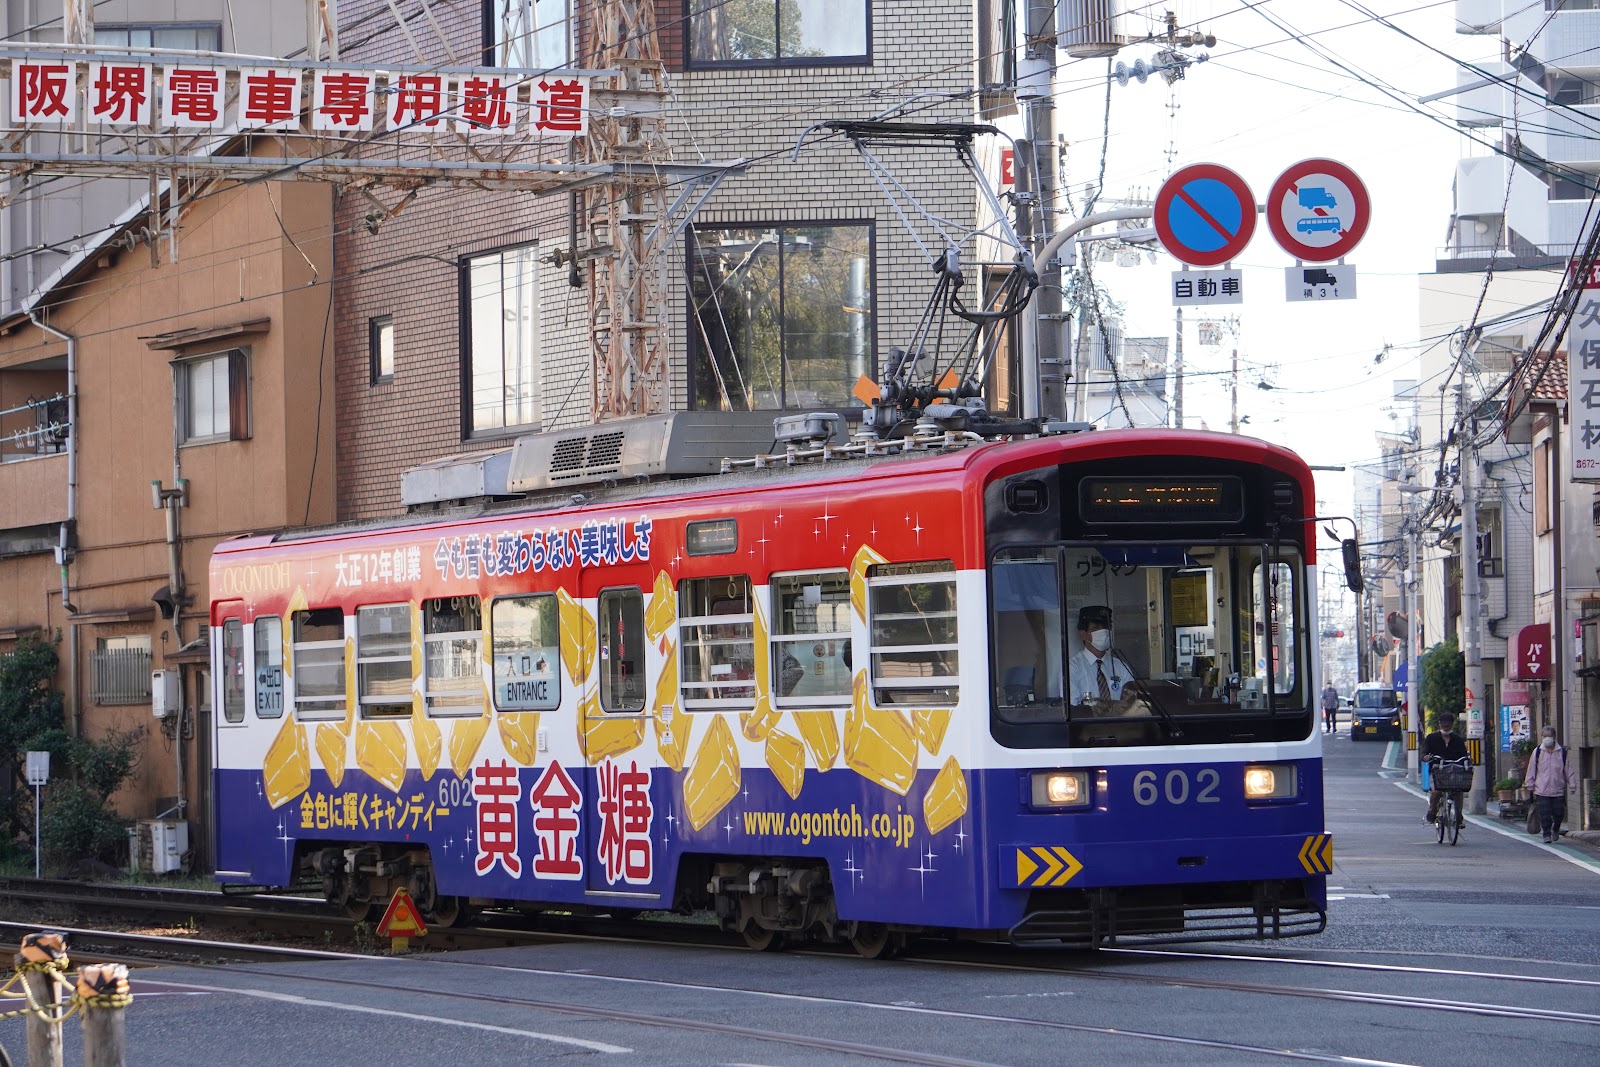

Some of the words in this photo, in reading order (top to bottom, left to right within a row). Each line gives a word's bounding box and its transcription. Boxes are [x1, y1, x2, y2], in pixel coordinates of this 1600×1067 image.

[19, 64, 584, 131] 阪堺電車専用軌道
[1175, 278, 1240, 298] 自動車
[335, 546, 421, 588] 大正12年創業
[433, 515, 652, 582] 今も昔も変わらない美味しさ
[223, 561, 291, 596] OGONTOH
[507, 656, 531, 677] 入口
[1527, 643, 1542, 674] パーマ
[266, 669, 281, 688] 出口
[507, 681, 547, 701] ENTRANCE
[258, 692, 281, 710] EXIT
[438, 778, 472, 808] 602
[1132, 768, 1221, 806] 602
[300, 791, 450, 831] 金色に輝くキャンディー
[473, 757, 652, 882] 黄金糖
[743, 804, 915, 848] www.ogontoh.co.jp
